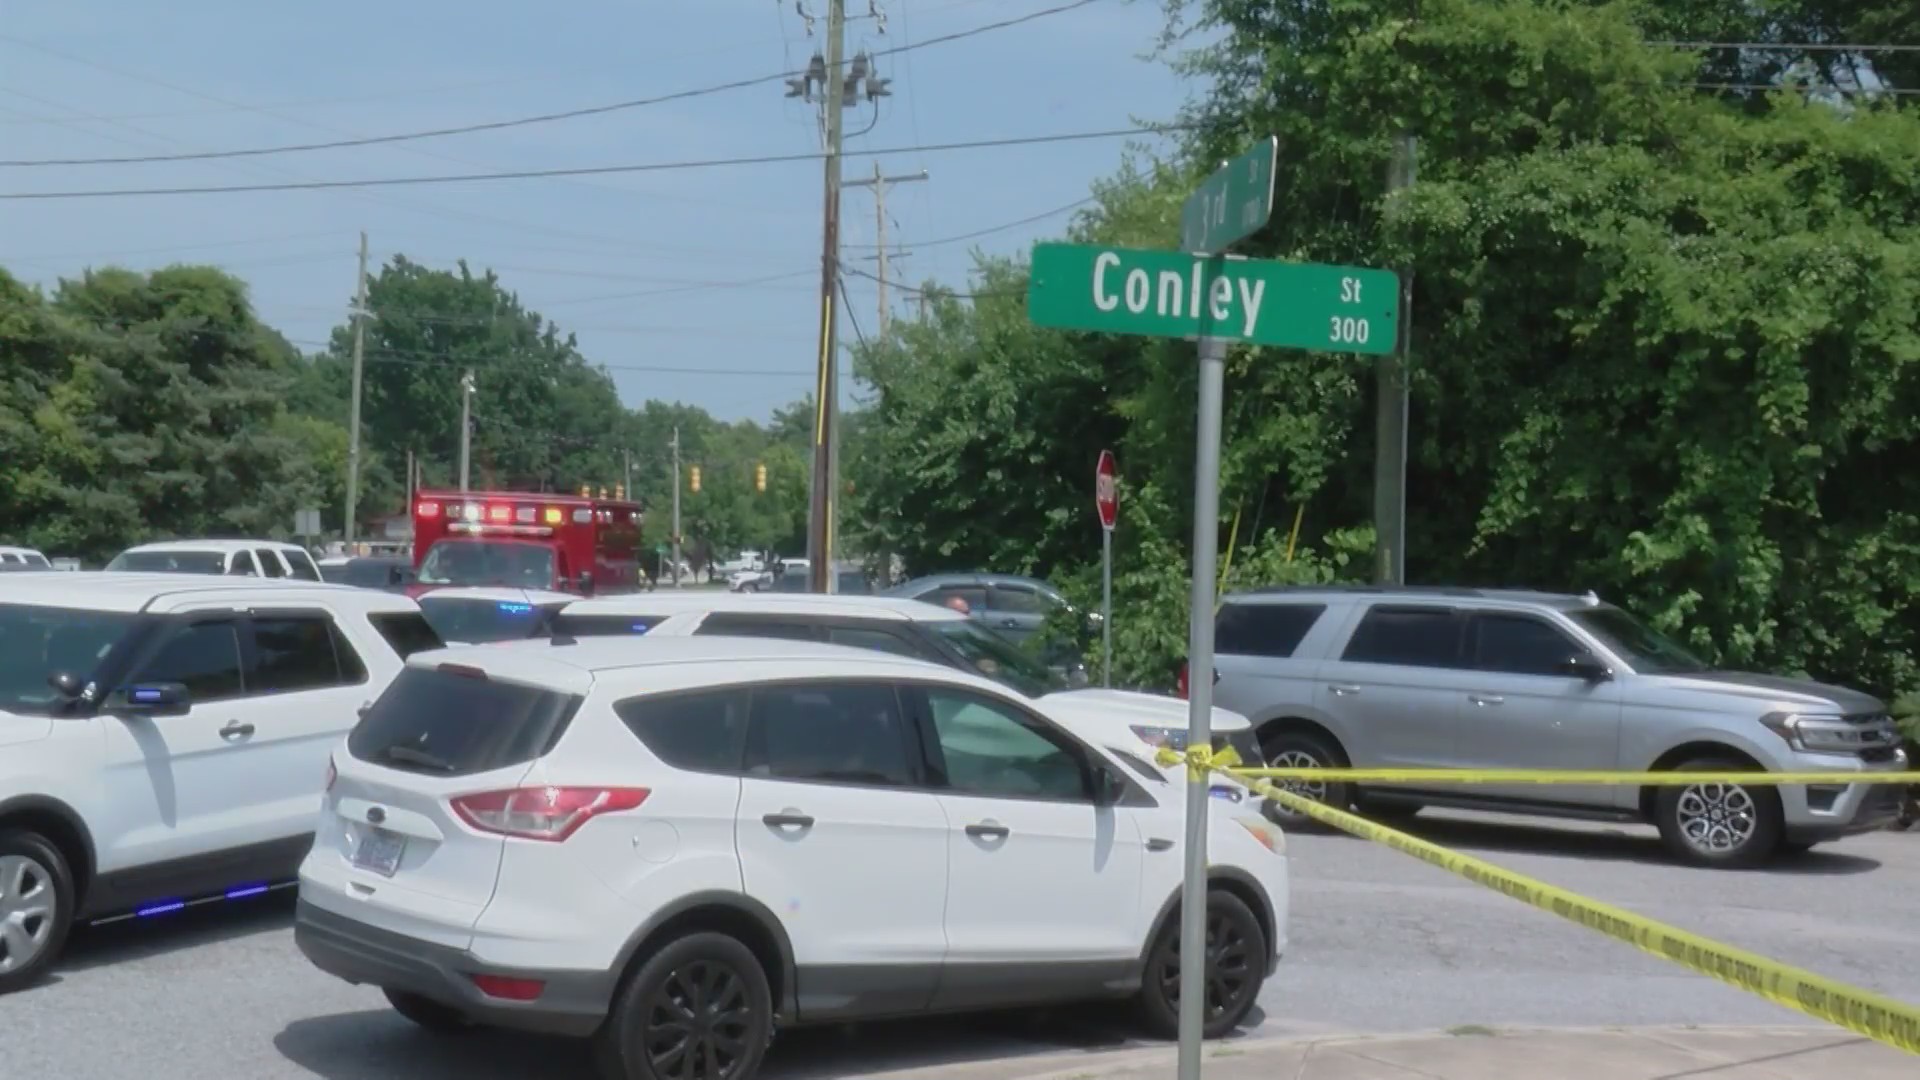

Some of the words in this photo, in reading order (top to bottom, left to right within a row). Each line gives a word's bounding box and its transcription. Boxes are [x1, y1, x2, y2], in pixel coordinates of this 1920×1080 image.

[1093, 251, 1266, 338] Conley
[1340, 276, 1363, 304] St
[1330, 316, 1370, 345] 300
